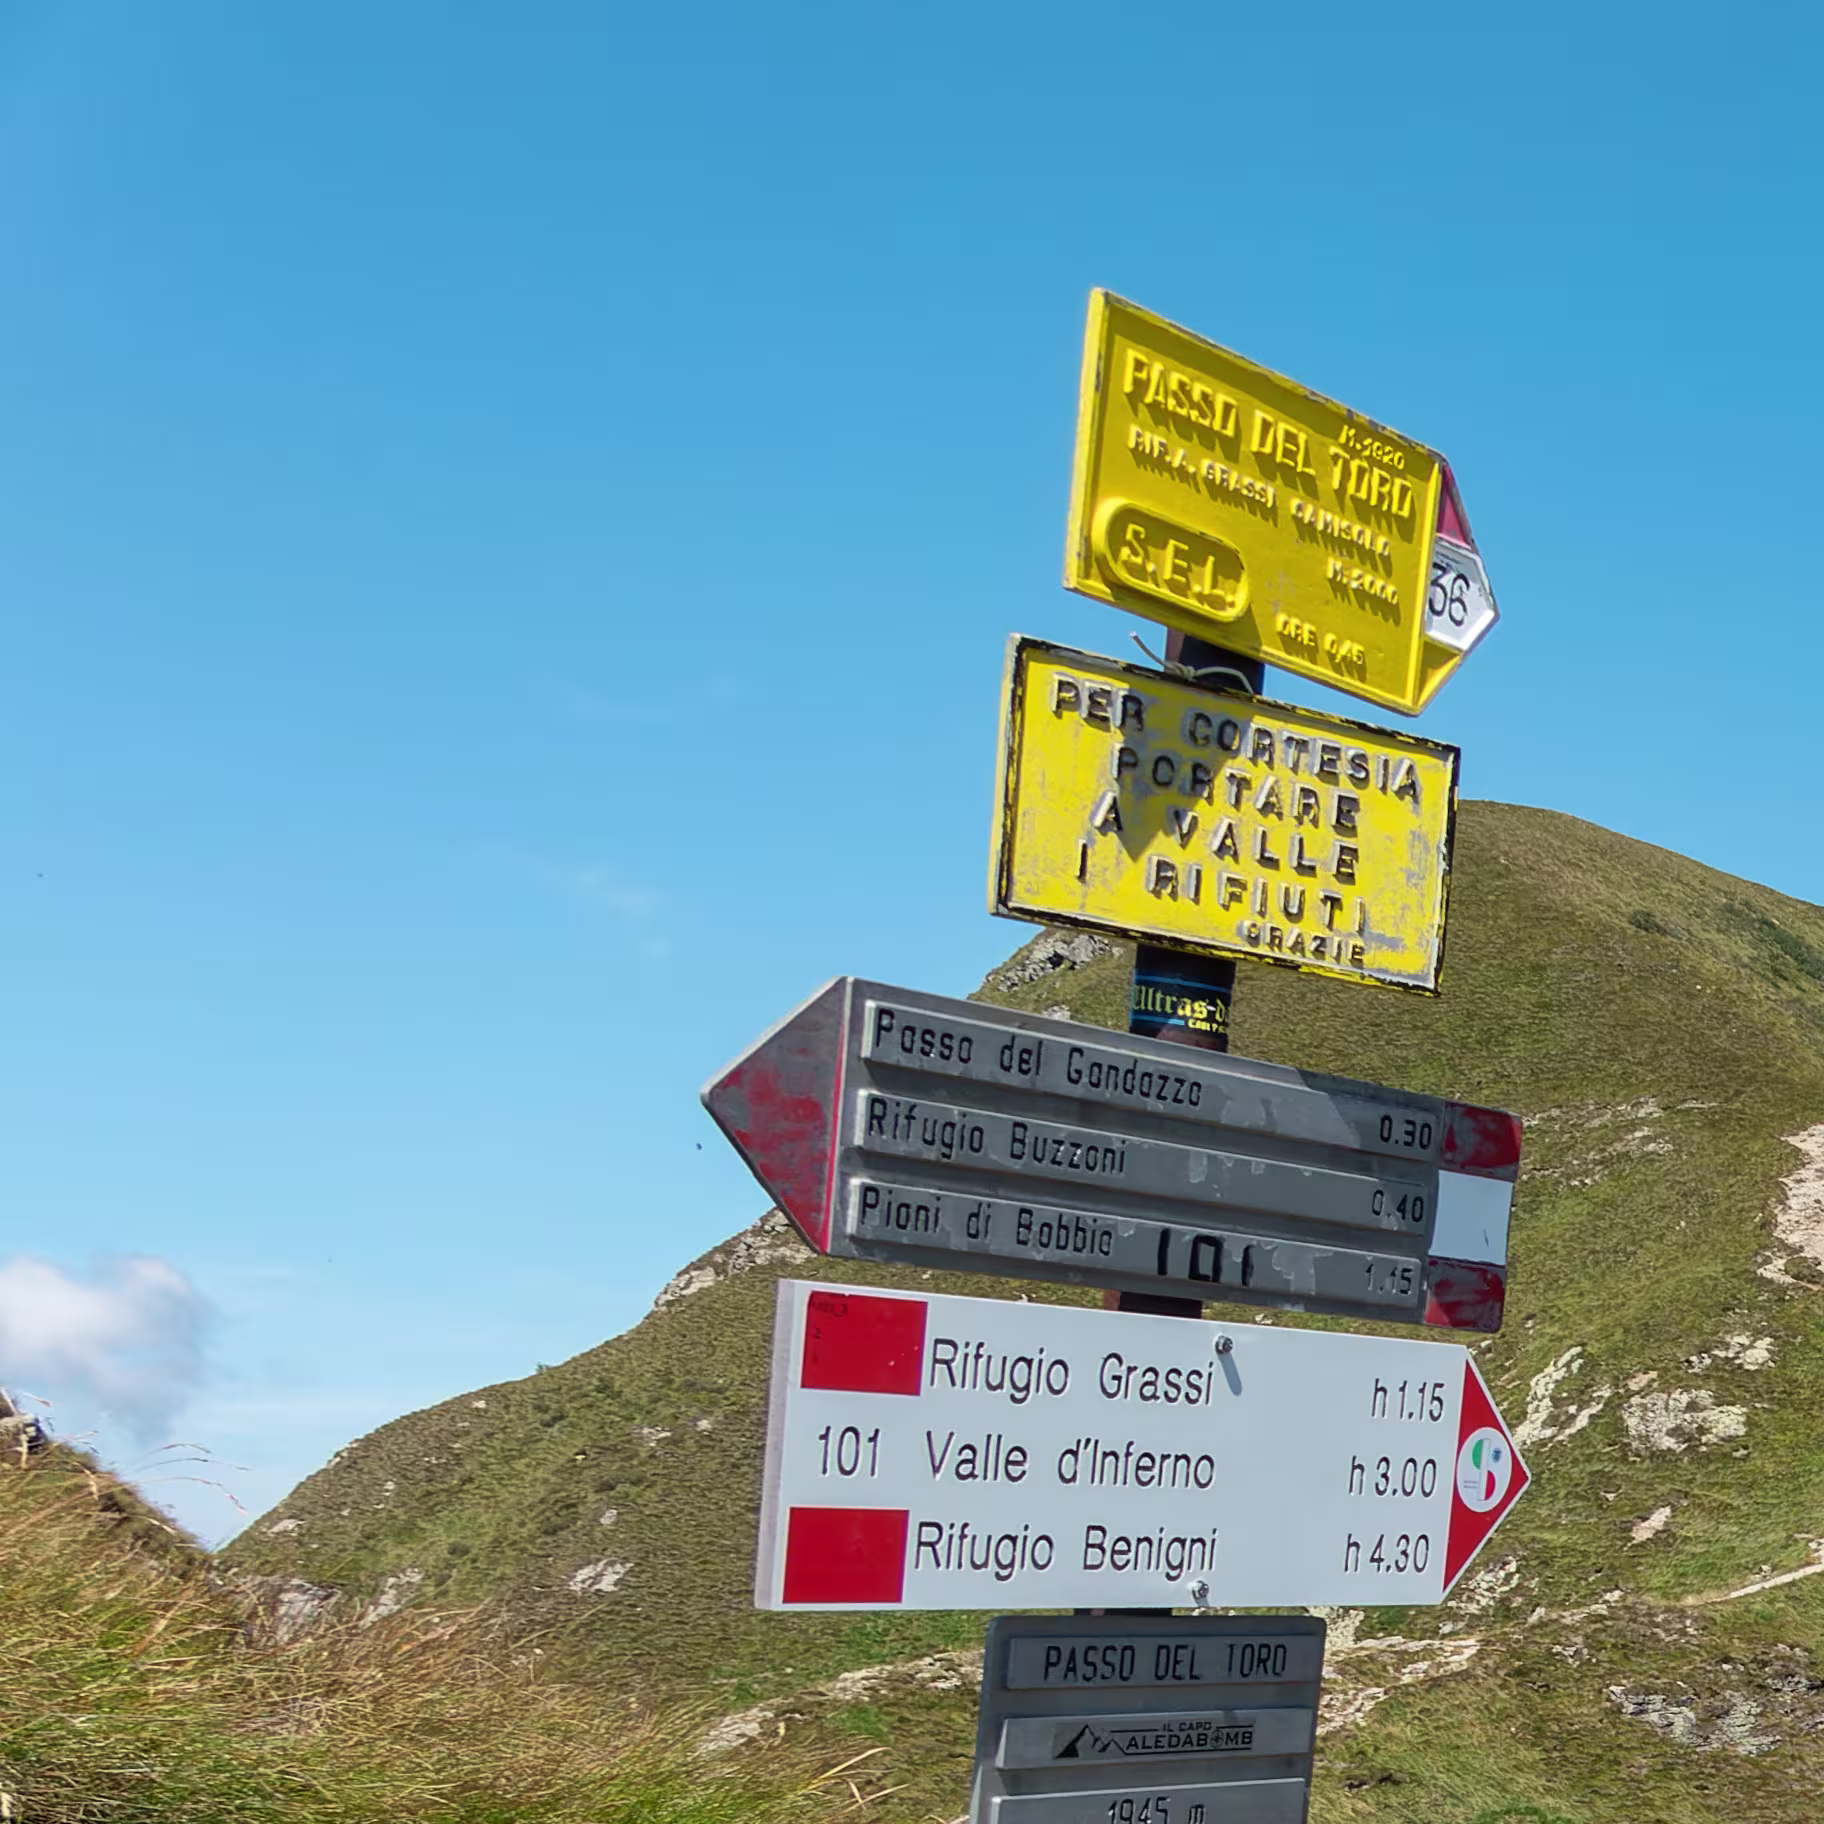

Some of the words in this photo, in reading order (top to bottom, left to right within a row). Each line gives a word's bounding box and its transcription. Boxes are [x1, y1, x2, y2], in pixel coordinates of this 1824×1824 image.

[1123, 348, 1237, 437] PASSO
[1251, 409, 1316, 476] DEL
[1329, 445, 1413, 519] TORO
[1275, 612, 1317, 646] ORE
[1428, 561, 1470, 627] 36
[1050, 672, 1144, 732] PER
[1186, 710, 1421, 799] CORTESIA
[1111, 743, 1360, 833] PORTARE
[1091, 790, 1124, 833] A
[1170, 807, 1360, 886] VALLE
[1077, 838, 1089, 884] I
[1148, 854, 1367, 936] RIFIUTI
[1243, 919, 1365, 968] GRAZIE
[1001, 1034, 1043, 1076] del
[1378, 1113, 1432, 1151] 0.30
[868, 1096, 985, 1161] Rifugio
[1010, 1121, 1127, 1175] Buzzoni
[1371, 1188, 1424, 1222] 0.40
[965, 1201, 992, 1240] di
[1015, 1207, 1113, 1257] Bobbio
[1365, 1261, 1413, 1296] 1.15
[930, 1337, 1070, 1405] Rifugio
[1100, 1352, 1214, 1405] Grassi
[1371, 1378, 1388, 1418] h
[1398, 1380, 1445, 1422] 1.15
[819, 1425, 880, 1477] 101
[926, 1430, 1028, 1483] Valle
[1057, 1437, 1215, 1489] d'Inferno
[1348, 1456, 1366, 1496] h
[1375, 1457, 1437, 1498] 3.00
[914, 1521, 1054, 1582] Rifugio
[1083, 1525, 1218, 1582] Benigni
[1344, 1533, 1361, 1573] h
[1370, 1533, 1429, 1574] 4.30
[1044, 1645, 1135, 1681] PASSO
[1154, 1645, 1202, 1681] DEL
[1227, 1643, 1287, 1678] TORO
